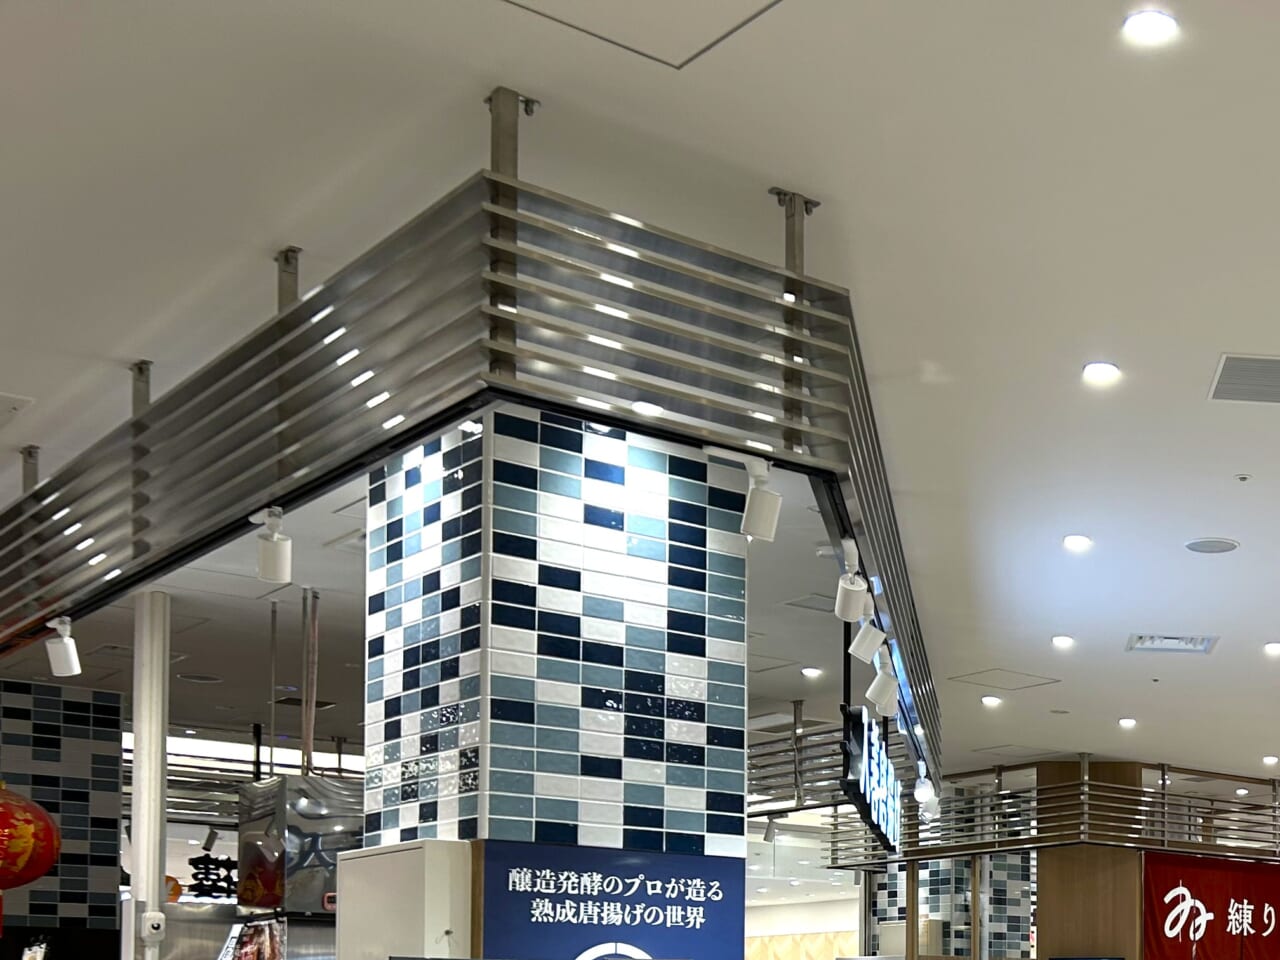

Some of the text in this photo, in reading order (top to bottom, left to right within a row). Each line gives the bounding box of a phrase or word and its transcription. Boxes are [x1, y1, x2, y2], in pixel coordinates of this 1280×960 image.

[508, 867, 723, 902] 醸造発酵のプロが造る
[530, 898, 706, 930] 熟成唐揚げの世界
